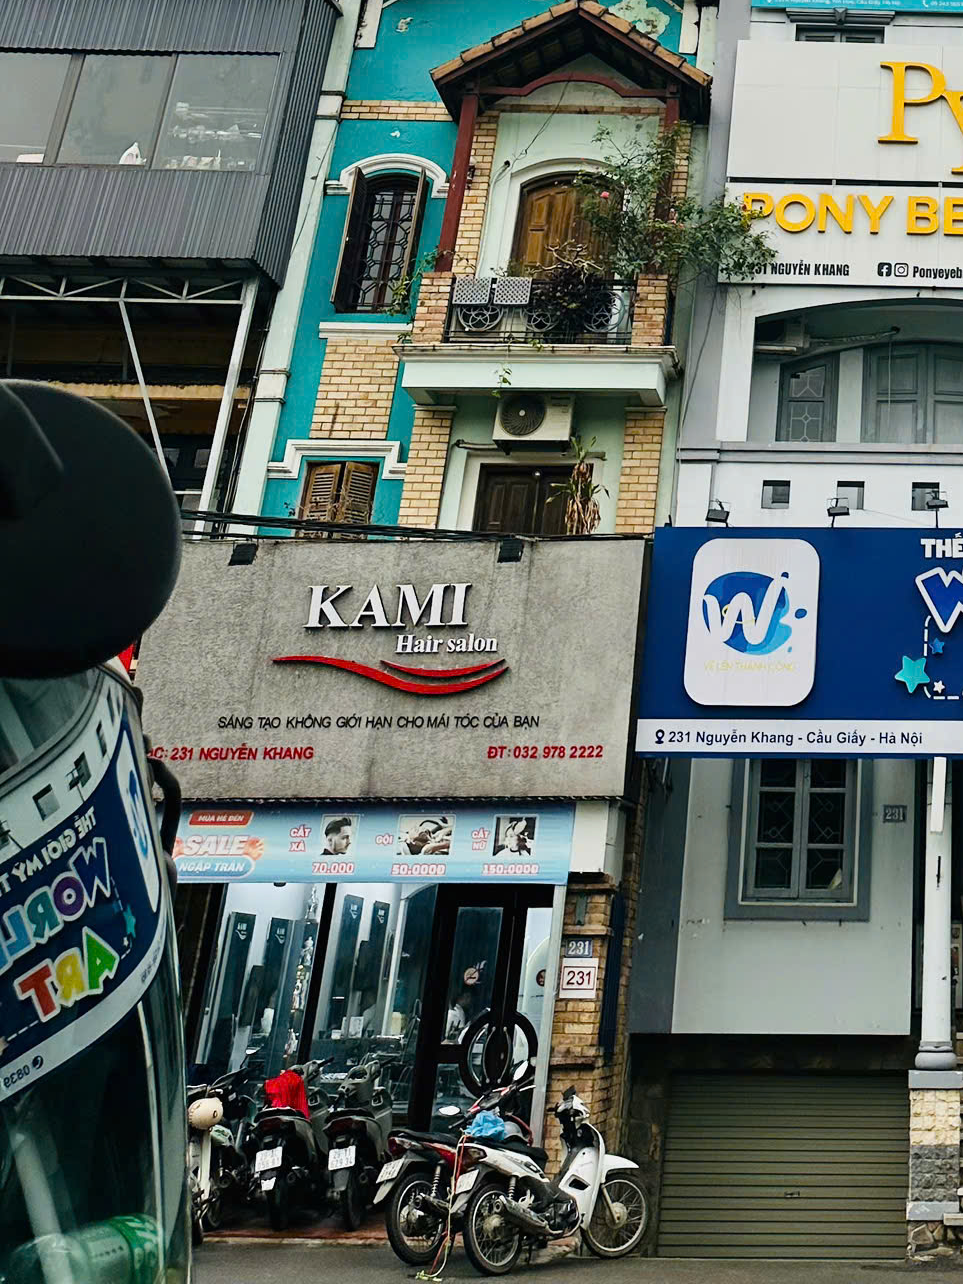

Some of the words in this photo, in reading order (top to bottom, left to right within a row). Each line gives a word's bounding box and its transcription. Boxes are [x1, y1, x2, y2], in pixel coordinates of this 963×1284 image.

[742, 192, 894, 235] PONY
[771, 260, 810, 275] NGUYỄN
[814, 264, 849, 276] KHANG
[303, 583, 472, 629] KAMI
[395, 634, 445, 654] Hair
[447, 634, 498, 653] salon
[218, 714, 253, 728] SÁNG
[258, 716, 281, 731] TẠO
[286, 714, 332, 728] KHÔNG
[336, 713, 361, 728] GIỚI
[366, 716, 392, 730] HẠN
[397, 716, 424, 728] CHO
[427, 713, 450, 727] MÁI
[454, 713, 480, 727] TÓC
[484, 712, 509, 727] CỦA
[514, 716, 540, 730] BẠN
[669, 731, 690, 743] 231
[696, 729, 746, 746] Nguyễn
[751, 731, 793, 746] Khang
[806, 729, 832, 744] Cầu
[836, 729, 866, 747] Giấy
[879, 731, 896, 744] Hà
[901, 732, 922, 747] Nội
[170, 747, 193, 760] 231
[199, 743, 257, 760] NGUYỄN
[263, 747, 314, 760] KHANG
[514, 746, 538, 759] 032
[543, 746, 566, 758] 978
[569, 745, 603, 758] 2222
[886, 808, 903, 820] 231
[290, 824, 311, 837] CẮT
[184, 834, 249, 856] SALE
[376, 834, 394, 846] GỘI
[179, 862, 211, 873] NGẬP
[214, 860, 245, 871] TRÀN
[312, 862, 354, 874] 70.000
[568, 941, 589, 955] 231
[567, 970, 591, 985] 231
